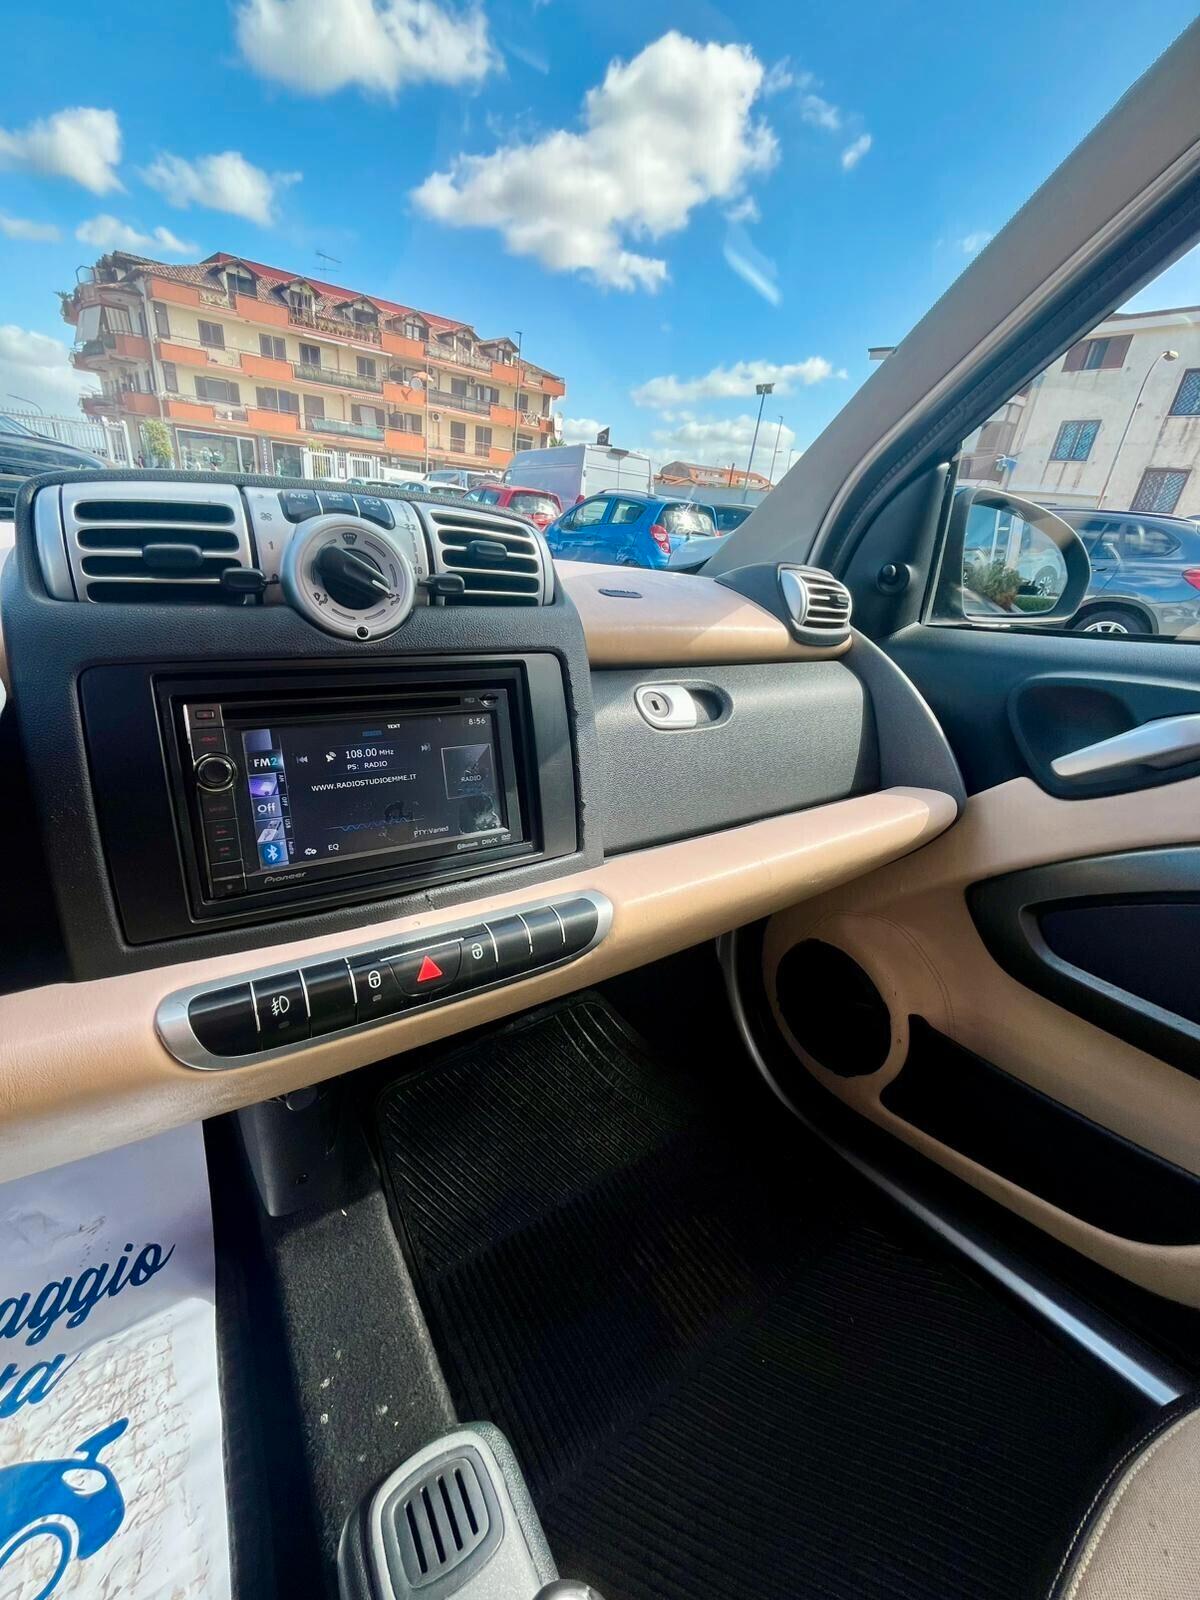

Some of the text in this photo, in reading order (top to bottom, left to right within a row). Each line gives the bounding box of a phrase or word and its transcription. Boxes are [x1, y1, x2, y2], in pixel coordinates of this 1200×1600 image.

[413, 566, 423, 575] 18
[345, 748, 377, 759] 108.00
[253, 757, 278, 767] FM2
[364, 760, 388, 769] RADIO
[311, 773, 417, 792] WWW.RADIOSTUDIOEMME.IT
[257, 803, 276, 813] Off
[264, 872, 307, 884] Pioneer
